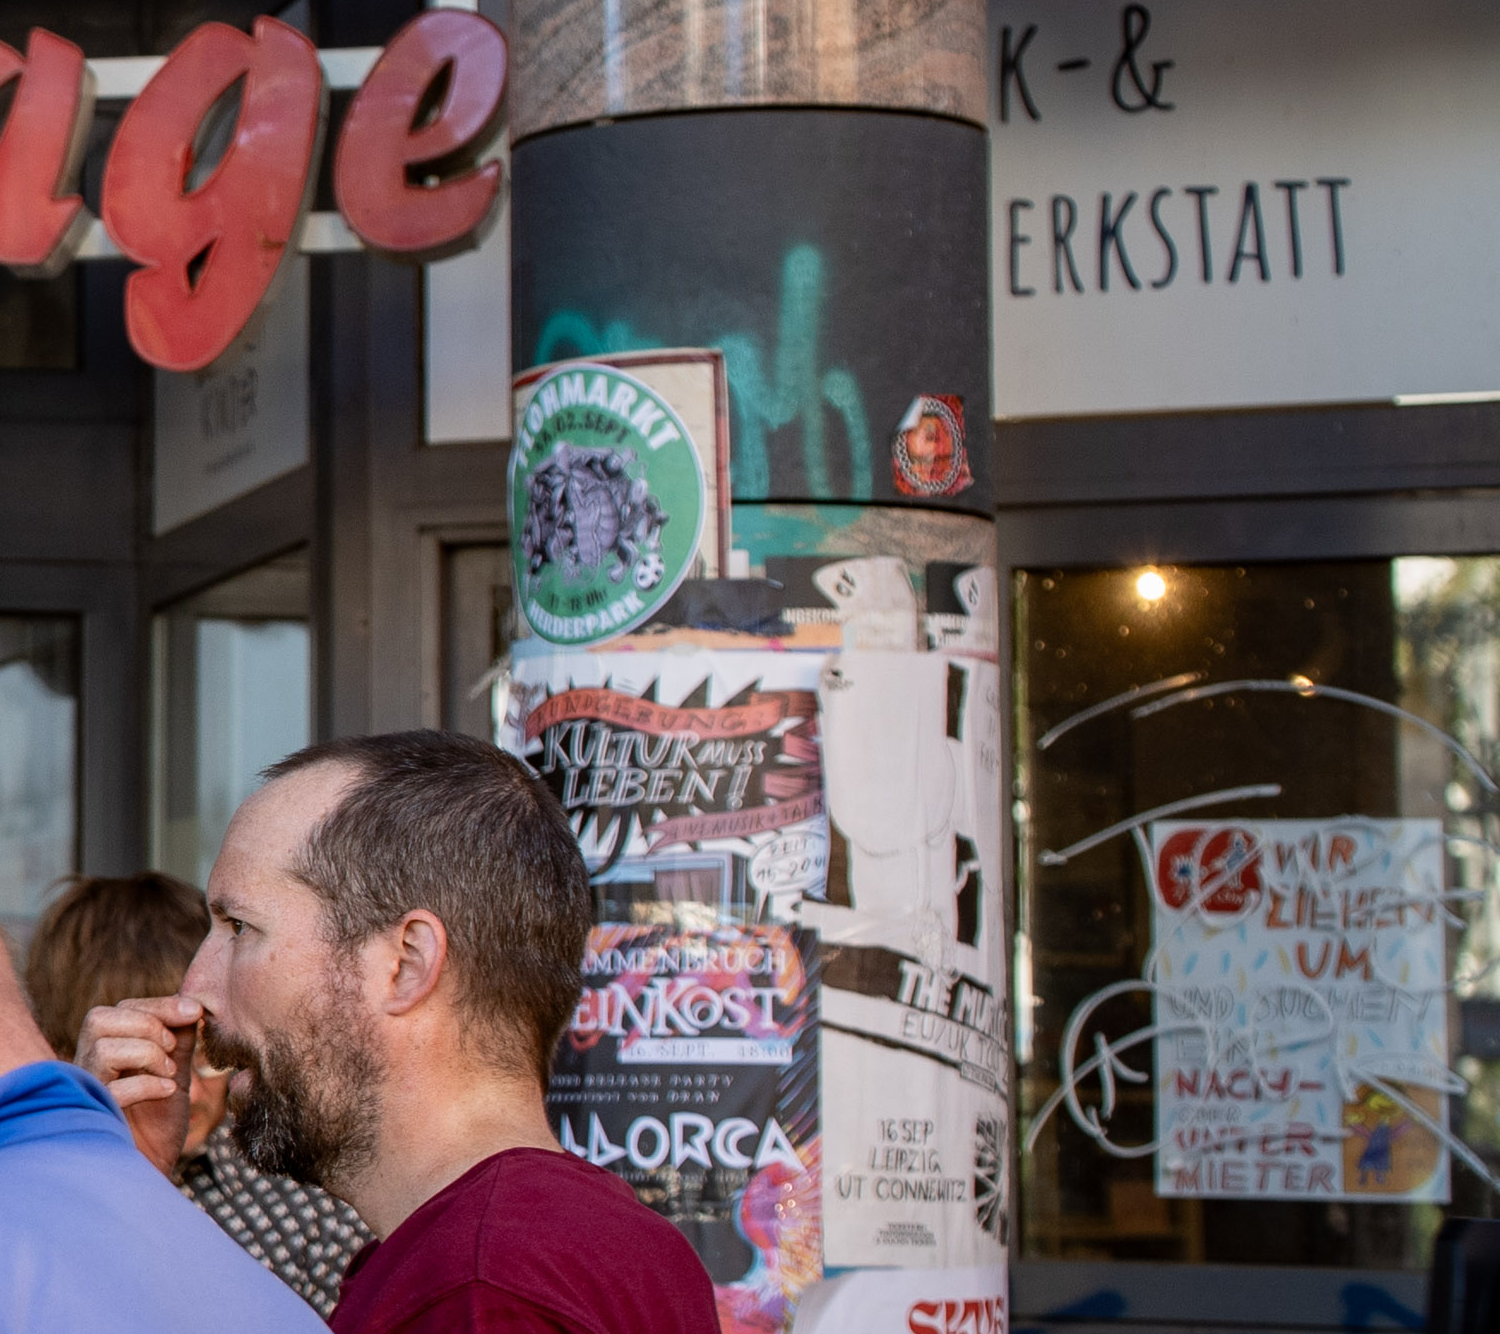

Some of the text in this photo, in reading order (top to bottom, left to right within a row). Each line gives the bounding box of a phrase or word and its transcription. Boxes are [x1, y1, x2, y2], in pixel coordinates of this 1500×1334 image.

[1112, 3, 1176, 113] &
[1007, 177, 1352, 299] ERKSTATT
[542, 718, 701, 773] KULTUR
[1296, 938, 1374, 981] UM
[870, 1147, 942, 1174] LEIPZIG
[1173, 1161, 1337, 1194] MIETER
[876, 1176, 968, 1203] CONNEWITZ
